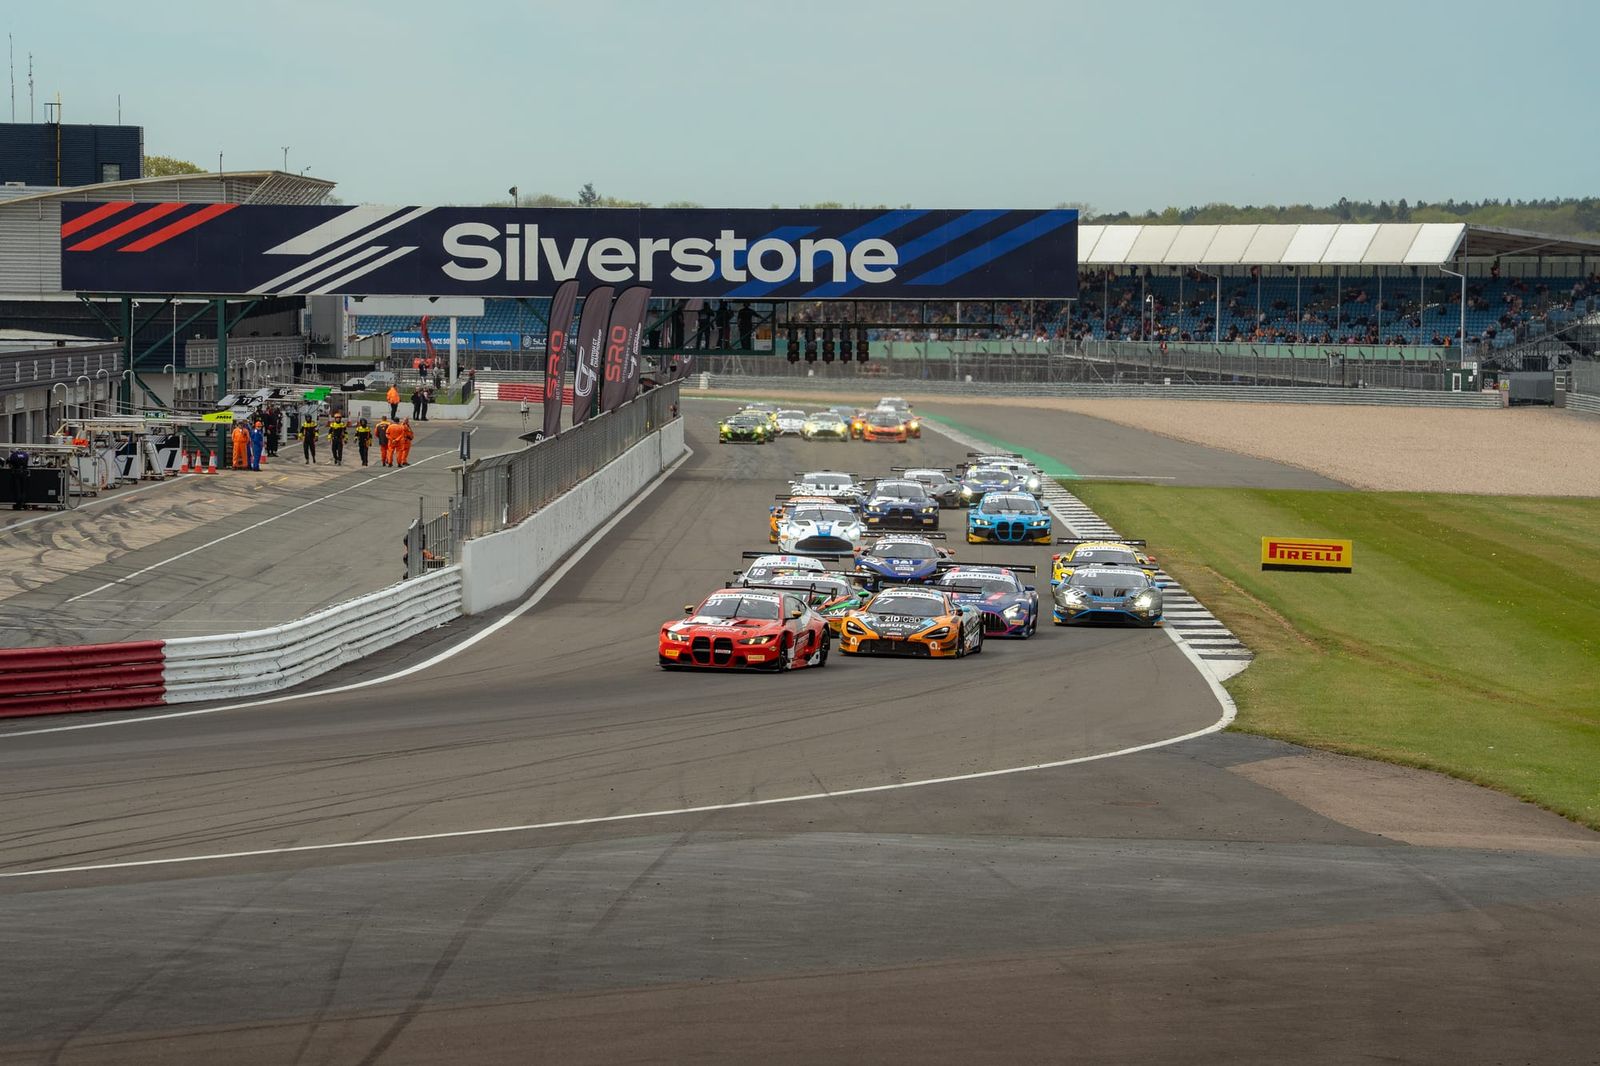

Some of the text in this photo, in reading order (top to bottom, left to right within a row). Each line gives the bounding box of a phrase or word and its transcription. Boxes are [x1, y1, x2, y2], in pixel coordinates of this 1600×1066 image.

[441, 222, 899, 283] Silverstone
[605, 325, 628, 382] SRO
[546, 330, 565, 399] SRO
[1268, 542, 1344, 562] PIRELLI
[751, 568, 766, 576] 18
[874, 597, 894, 605] 77
[884, 615, 900, 623] zip
